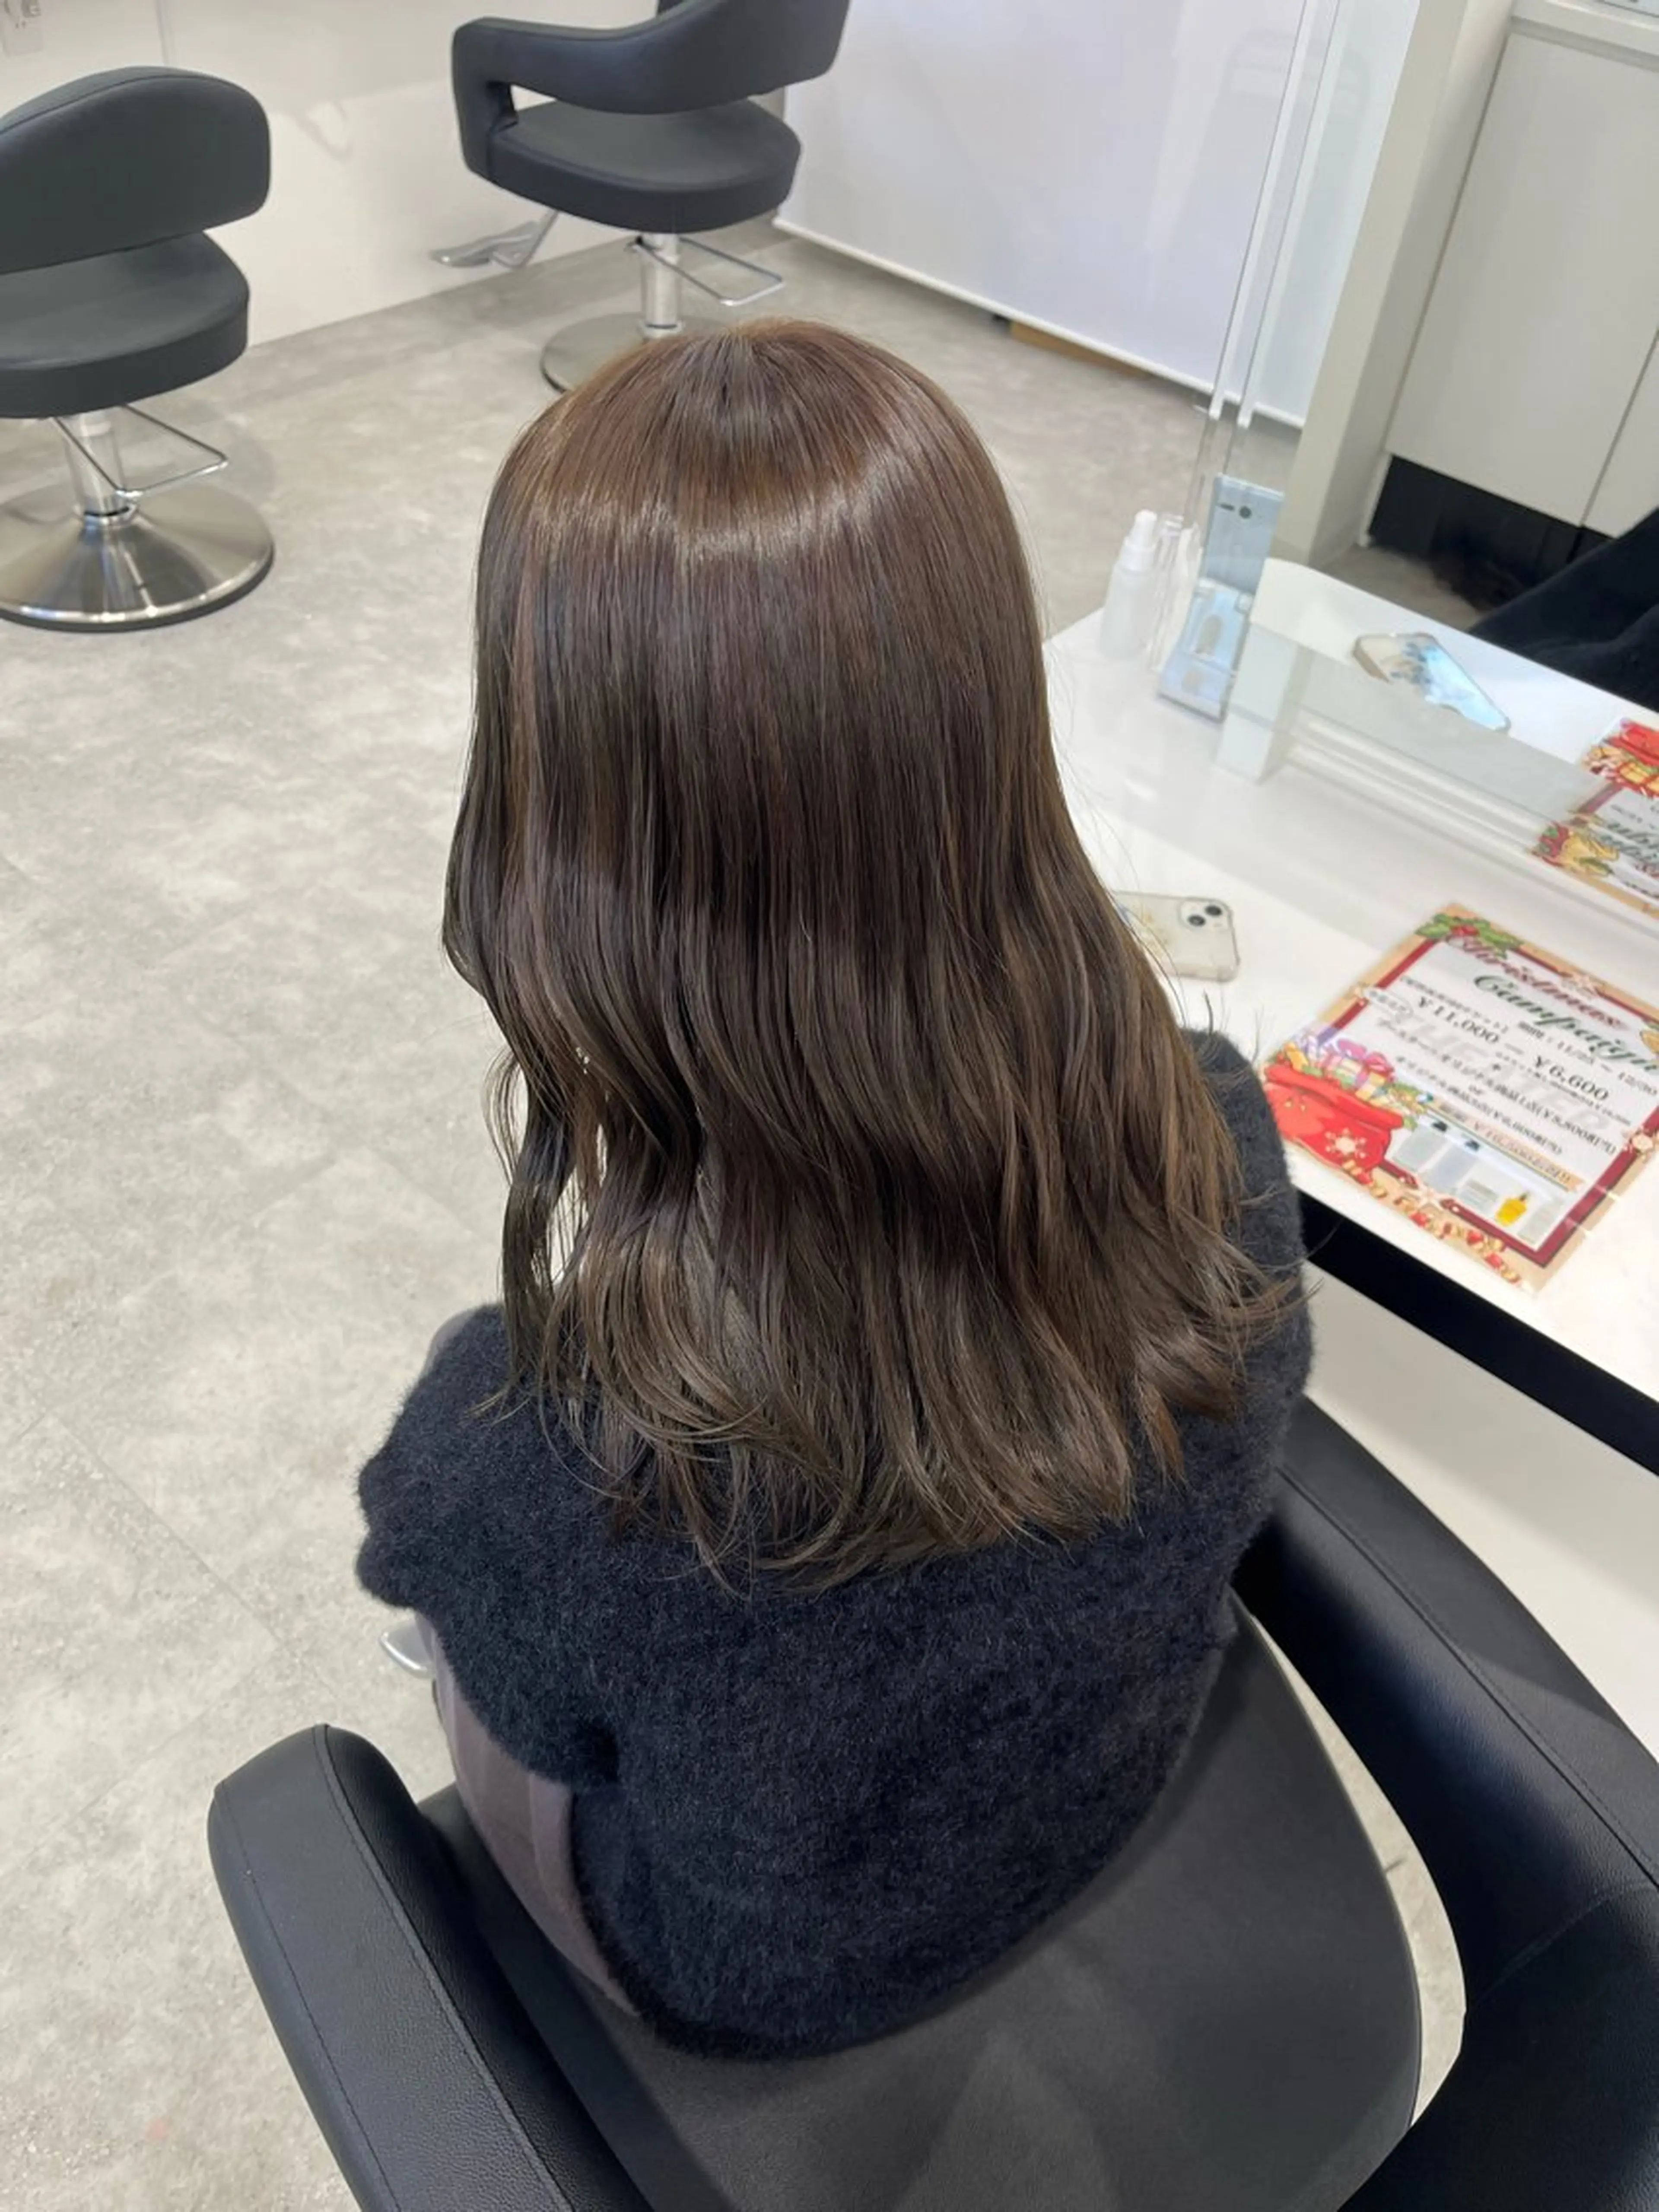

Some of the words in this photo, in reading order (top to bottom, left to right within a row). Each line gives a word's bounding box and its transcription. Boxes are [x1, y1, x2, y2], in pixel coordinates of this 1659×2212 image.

[1418, 995, 1500, 1043] ¥11,000
[1535, 1055, 1609, 1101] ¥6,600
[1473, 974, 1658, 1076] Campaign
